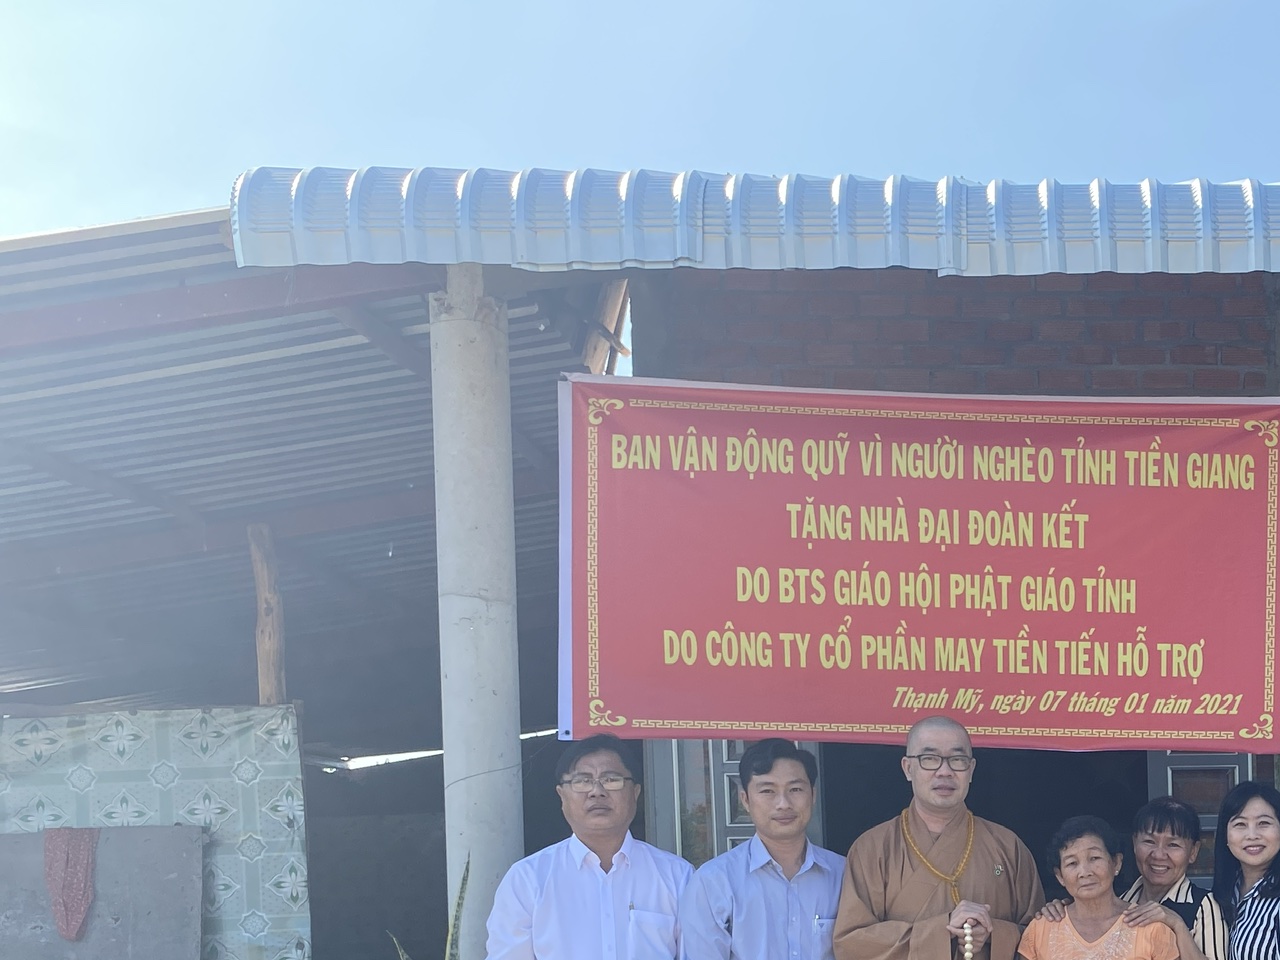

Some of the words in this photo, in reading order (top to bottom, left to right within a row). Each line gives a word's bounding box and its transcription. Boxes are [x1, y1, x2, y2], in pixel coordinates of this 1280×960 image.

[611, 433, 661, 471] BAN
[668, 426, 718, 478] VẬN
[725, 428, 794, 480] ĐỘNG
[801, 431, 850, 481] QUỸ
[859, 433, 883, 477] VÌ
[891, 434, 964, 480] NGƯỜI
[973, 437, 1055, 484] NGHÈO
[1061, 436, 1117, 486] TỈNH
[1124, 436, 1179, 488] TIỀN
[1186, 452, 1255, 491] GIANG
[785, 496, 852, 550] TẶNG
[859, 497, 910, 543] NHÀ
[917, 507, 960, 552] ĐẠI
[967, 500, 1034, 548] ĐOÀN
[1042, 498, 1090, 549] KẾT
[736, 566, 771, 604] DO
[778, 567, 827, 605] BTS
[833, 560, 892, 607] GIÁO
[899, 562, 941, 615] HỘI
[949, 564, 1012, 617] PHẬT
[1019, 564, 1076, 613] GIÁO
[1081, 563, 1137, 614] TỈNH
[663, 629, 698, 666] DO
[705, 620, 773, 668] CÔNG
[778, 632, 811, 668] TY
[818, 614, 852, 670] CỔ
[860, 619, 926, 671] PHẦN
[934, 636, 986, 673] MAY
[992, 623, 1048, 674] TIỀN
[1054, 626, 1109, 676] TIẾN
[1117, 625, 1149, 678] HỖ
[1156, 638, 1205, 685] TRỢ
[892, 686, 949, 711] Thạnh
[952, 687, 984, 713] Mỹ,
[990, 691, 1035, 715] ngày
[1038, 690, 1068, 712] 07
[1067, 691, 1121, 717] tháng
[1123, 692, 1150, 714] 01
[1151, 694, 1191, 715] năm
[1193, 693, 1243, 715] 2021
